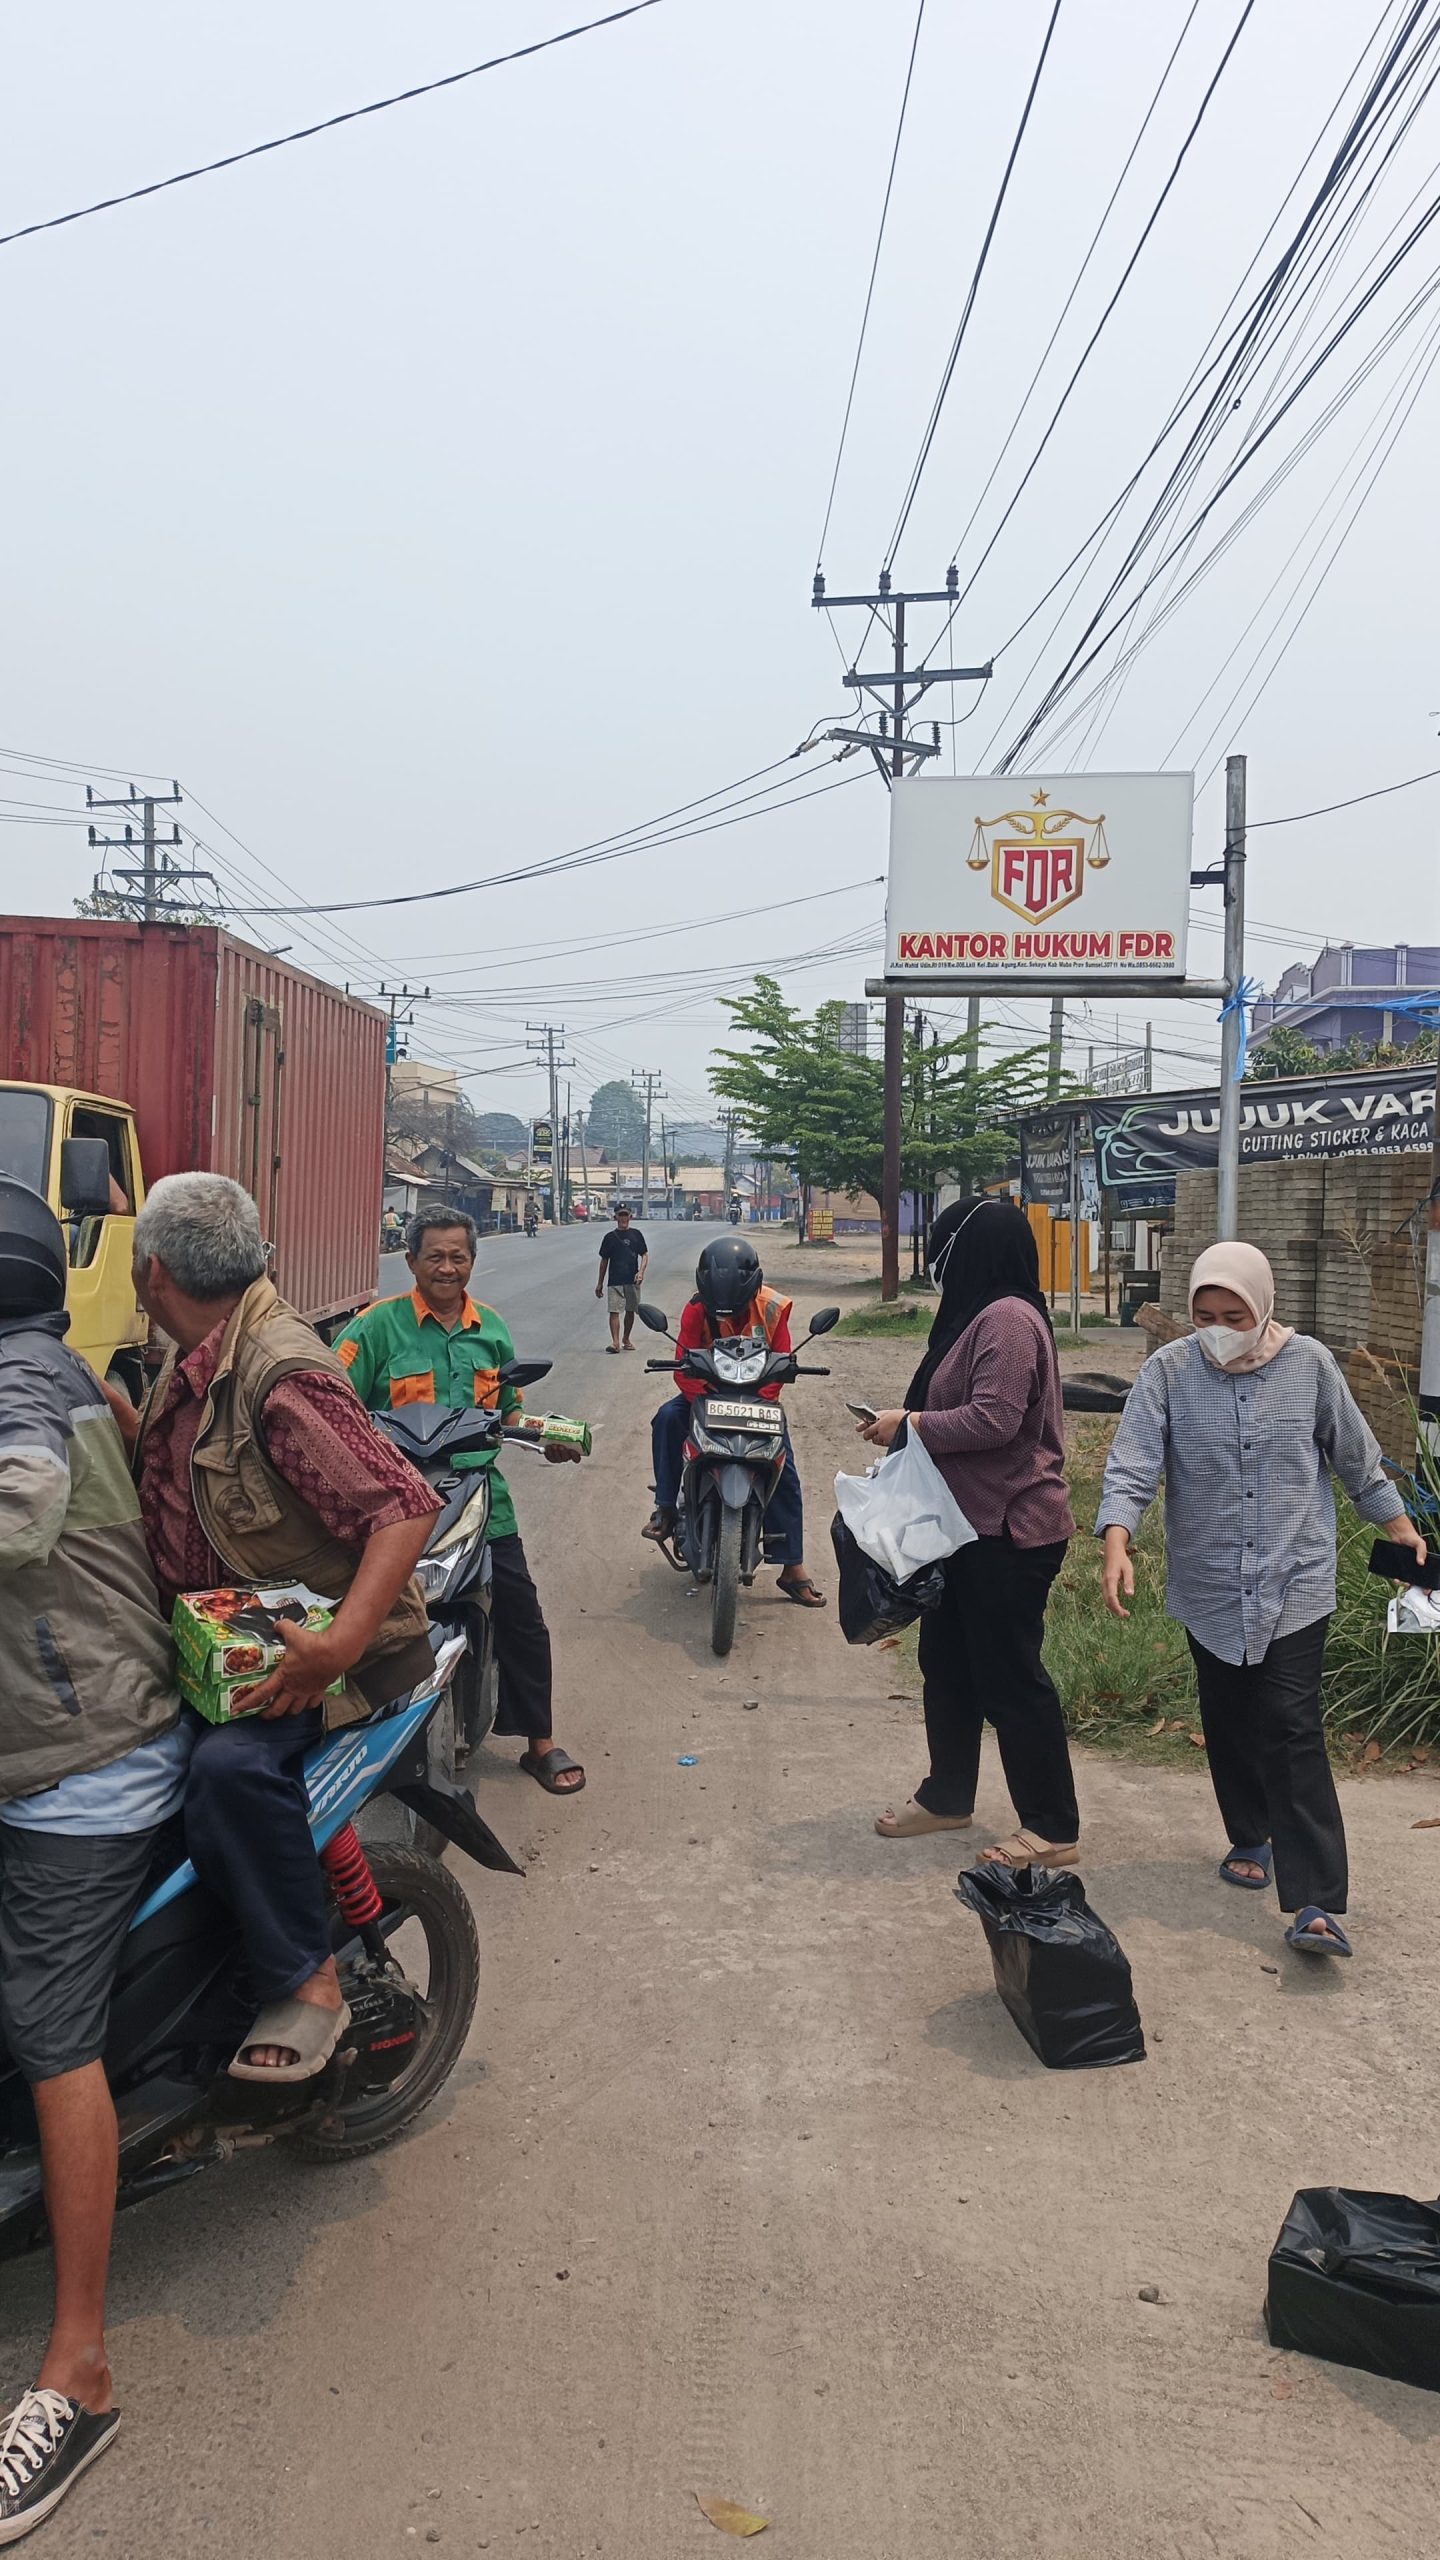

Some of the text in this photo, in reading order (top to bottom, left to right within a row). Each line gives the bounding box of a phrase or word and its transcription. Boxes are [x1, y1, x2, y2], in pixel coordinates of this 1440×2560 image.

[1003, 849, 1073, 913] FDR
[899, 932, 1174, 958] KANTOR HUKUM FDR
[1242, 1121, 1429, 1153] CUTTING STICKER & KACA
[709, 1403, 724, 1415] BG
[726, 1405, 753, 1418] 5021
